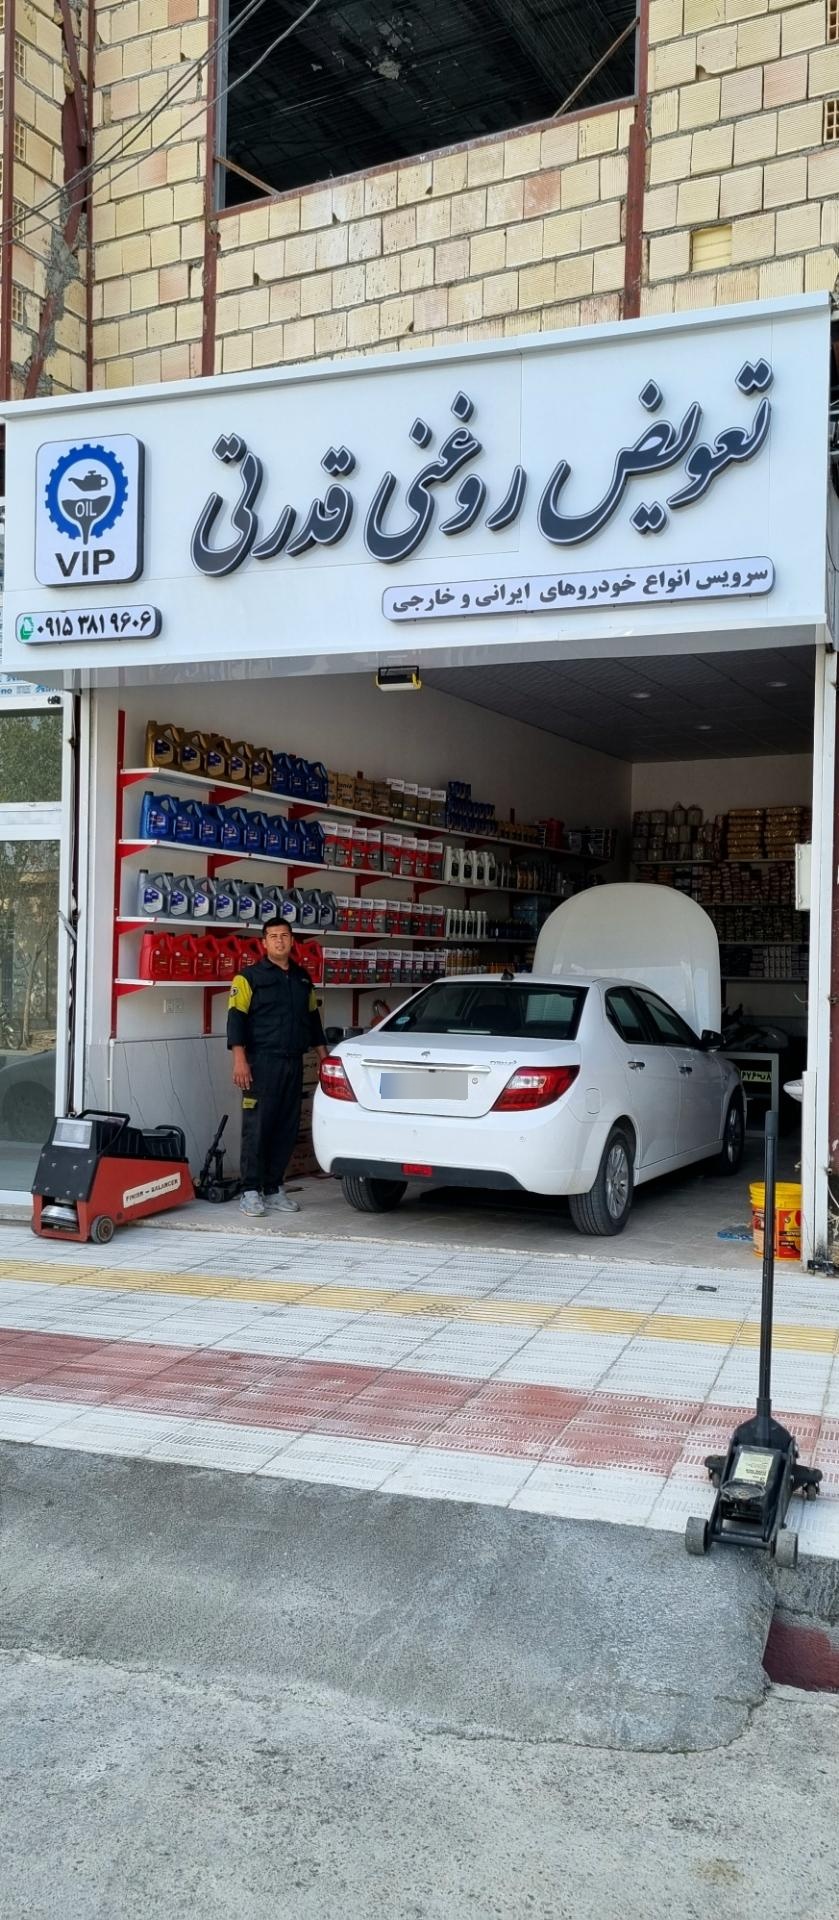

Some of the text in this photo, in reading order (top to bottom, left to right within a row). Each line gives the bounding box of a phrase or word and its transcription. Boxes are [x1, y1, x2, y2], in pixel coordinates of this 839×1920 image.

[190, 357, 774, 577] تعویض روغنی قدرتی
[75, 501, 97, 517] OIL
[54, 549, 116, 577] VIP
[392, 568, 768, 613] سرویس انواع خودروهای ایرانی و خارجی
[37, 611, 151, 636] ۰۹۱۵ ۳۸۱ ۹۶۰۶
